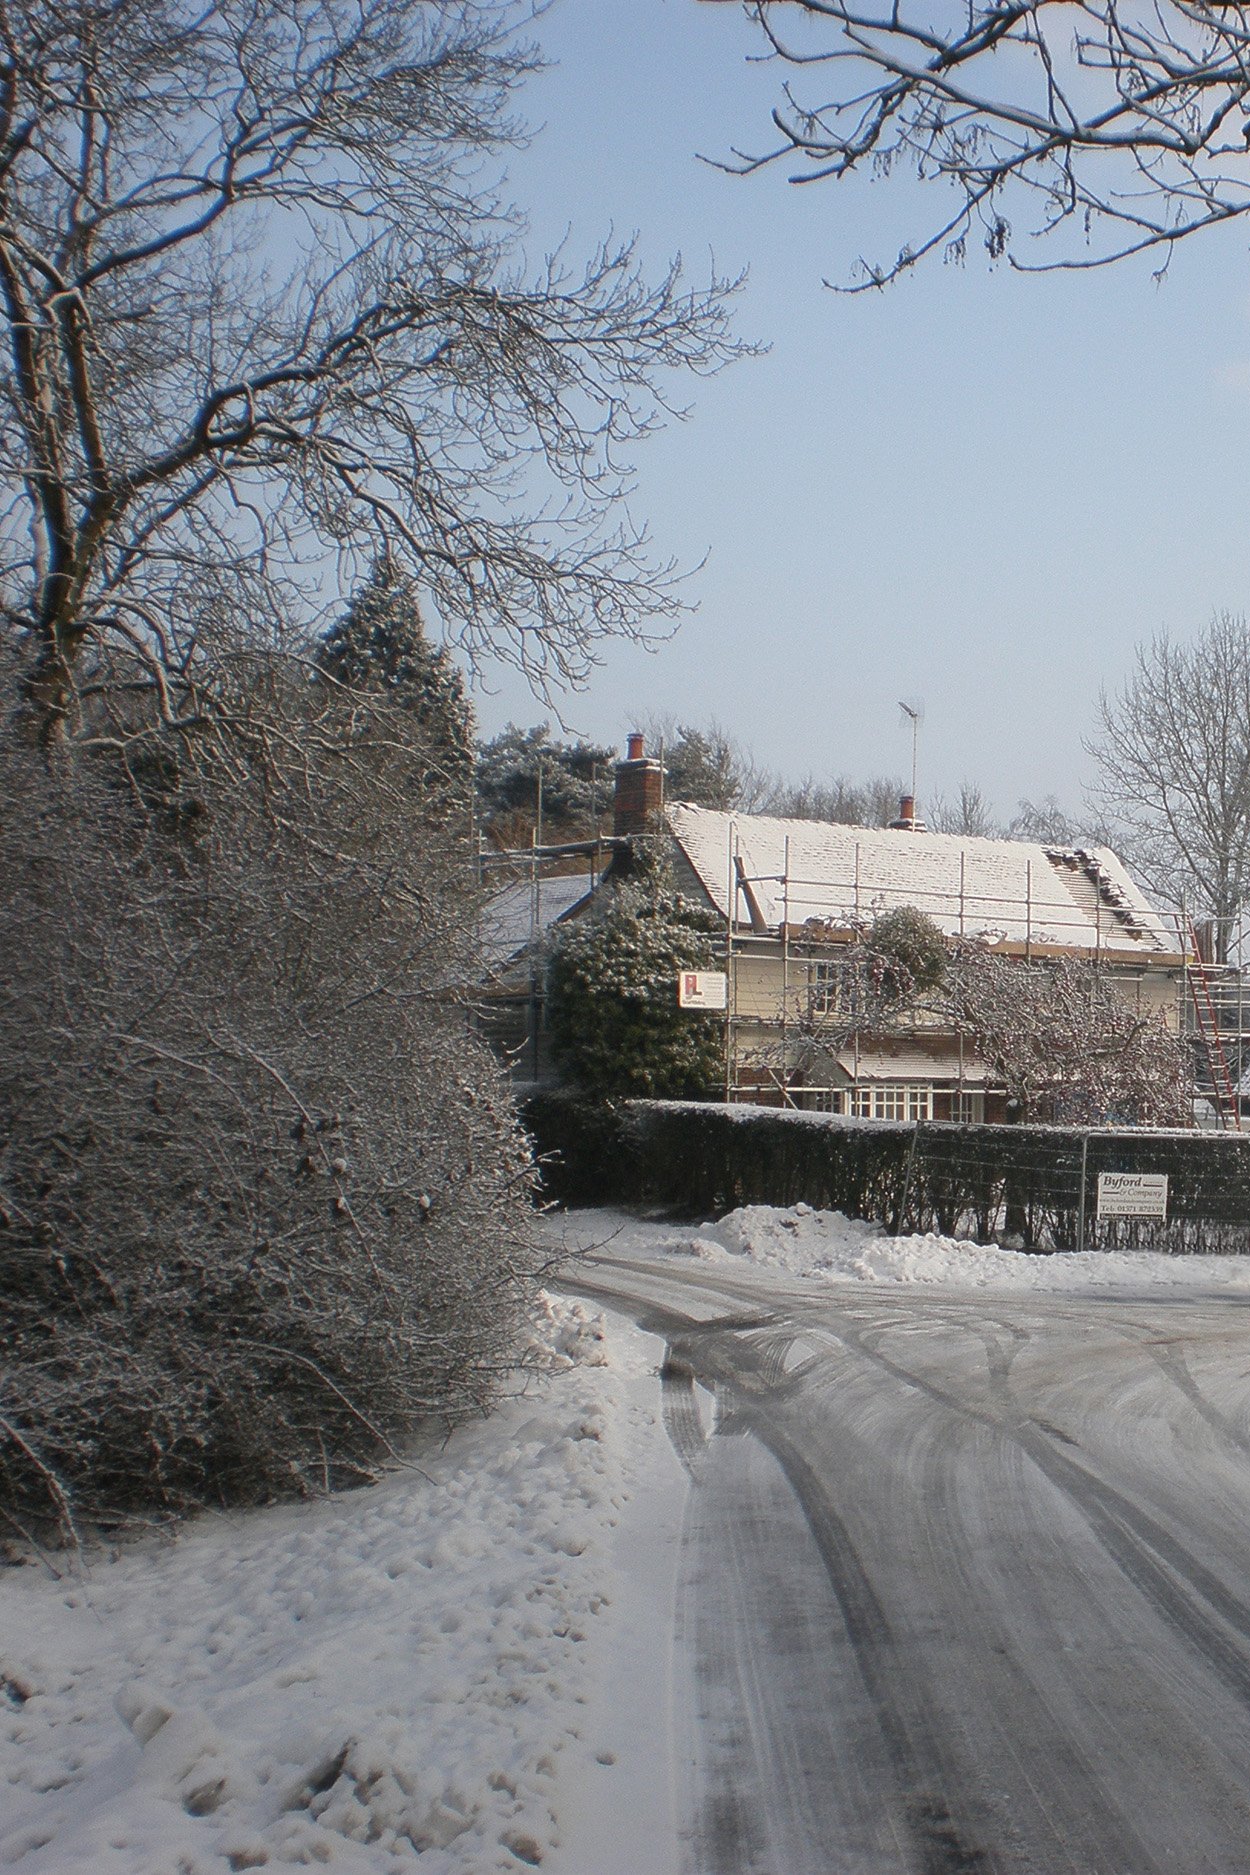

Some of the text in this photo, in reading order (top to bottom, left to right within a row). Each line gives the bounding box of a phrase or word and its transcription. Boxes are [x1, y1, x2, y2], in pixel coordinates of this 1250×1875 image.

[1103, 1176, 1142, 1189] Byford
[1119, 1188, 1163, 1199] & Company
